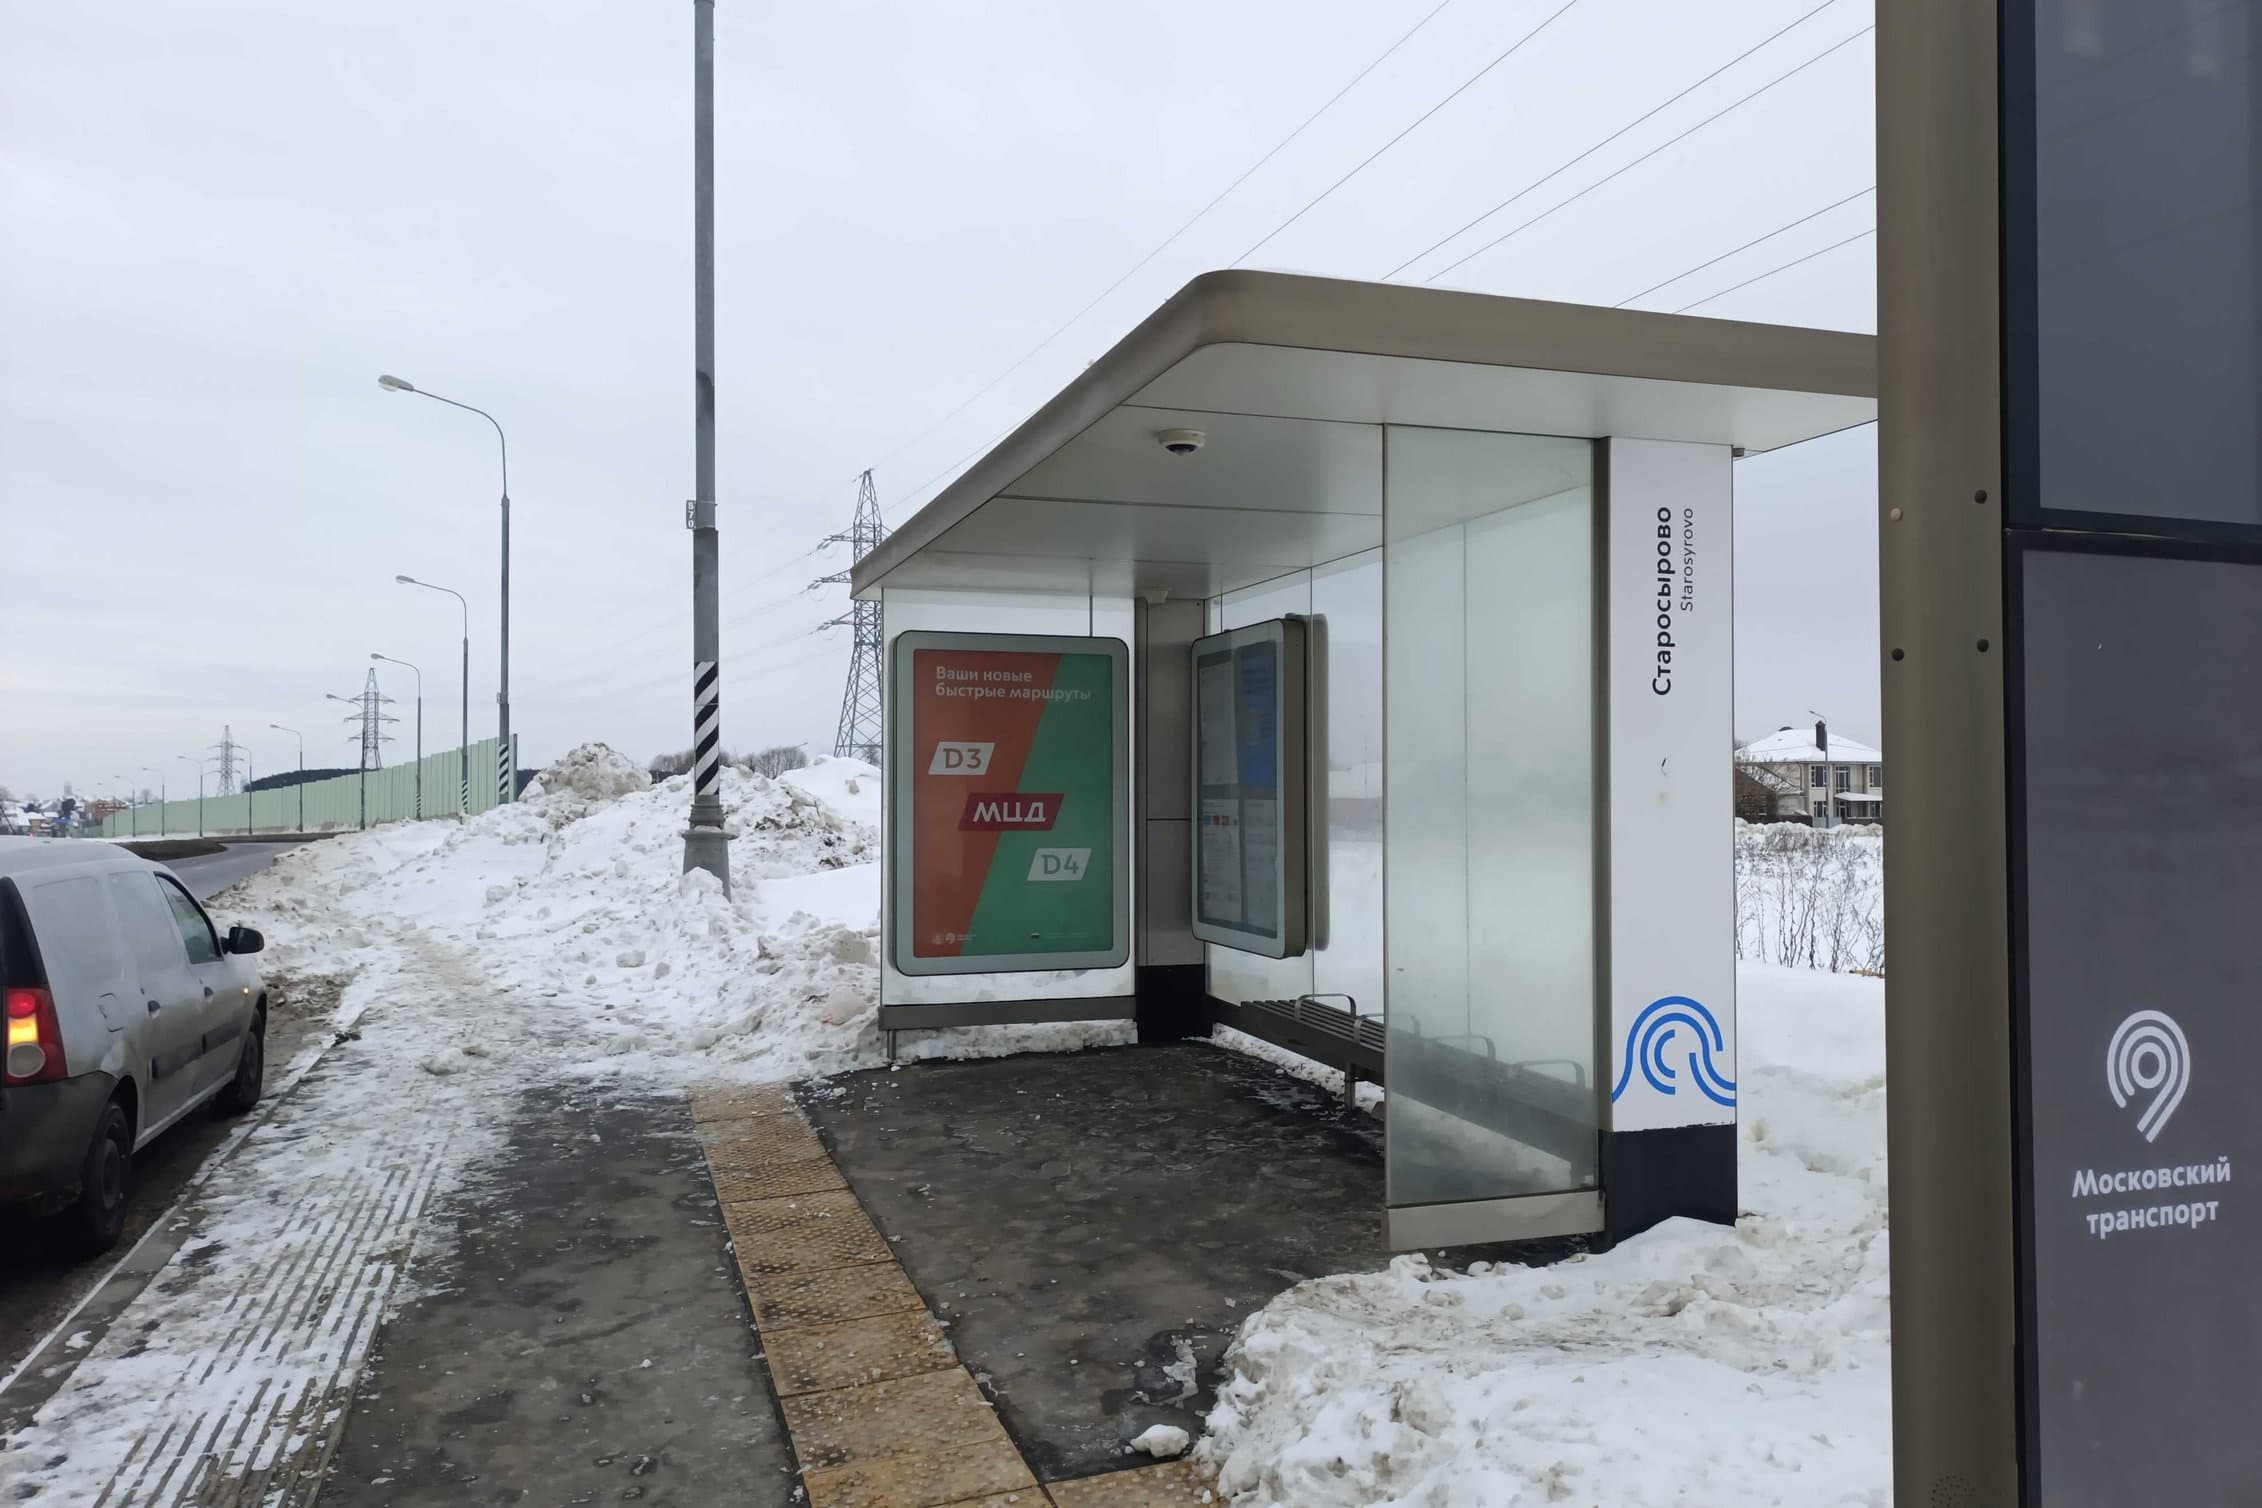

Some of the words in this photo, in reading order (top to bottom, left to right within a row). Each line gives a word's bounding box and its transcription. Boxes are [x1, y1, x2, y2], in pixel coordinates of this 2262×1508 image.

[687, 502, 695, 528] 570
[1680, 508, 1697, 612] Starosyrovo
[1652, 506, 1676, 696] Старосырово
[936, 666, 978, 681] Ваши
[984, 669, 1032, 682] новые
[935, 682, 1006, 700] быстрые
[1009, 688, 1092, 703] маршруты
[943, 748, 982, 769] D3
[972, 801, 1046, 822] МЦД
[1041, 854, 1080, 875] D4
[2071, 1155, 2232, 1198] Московский
[2086, 1201, 2220, 1240] транспорт
